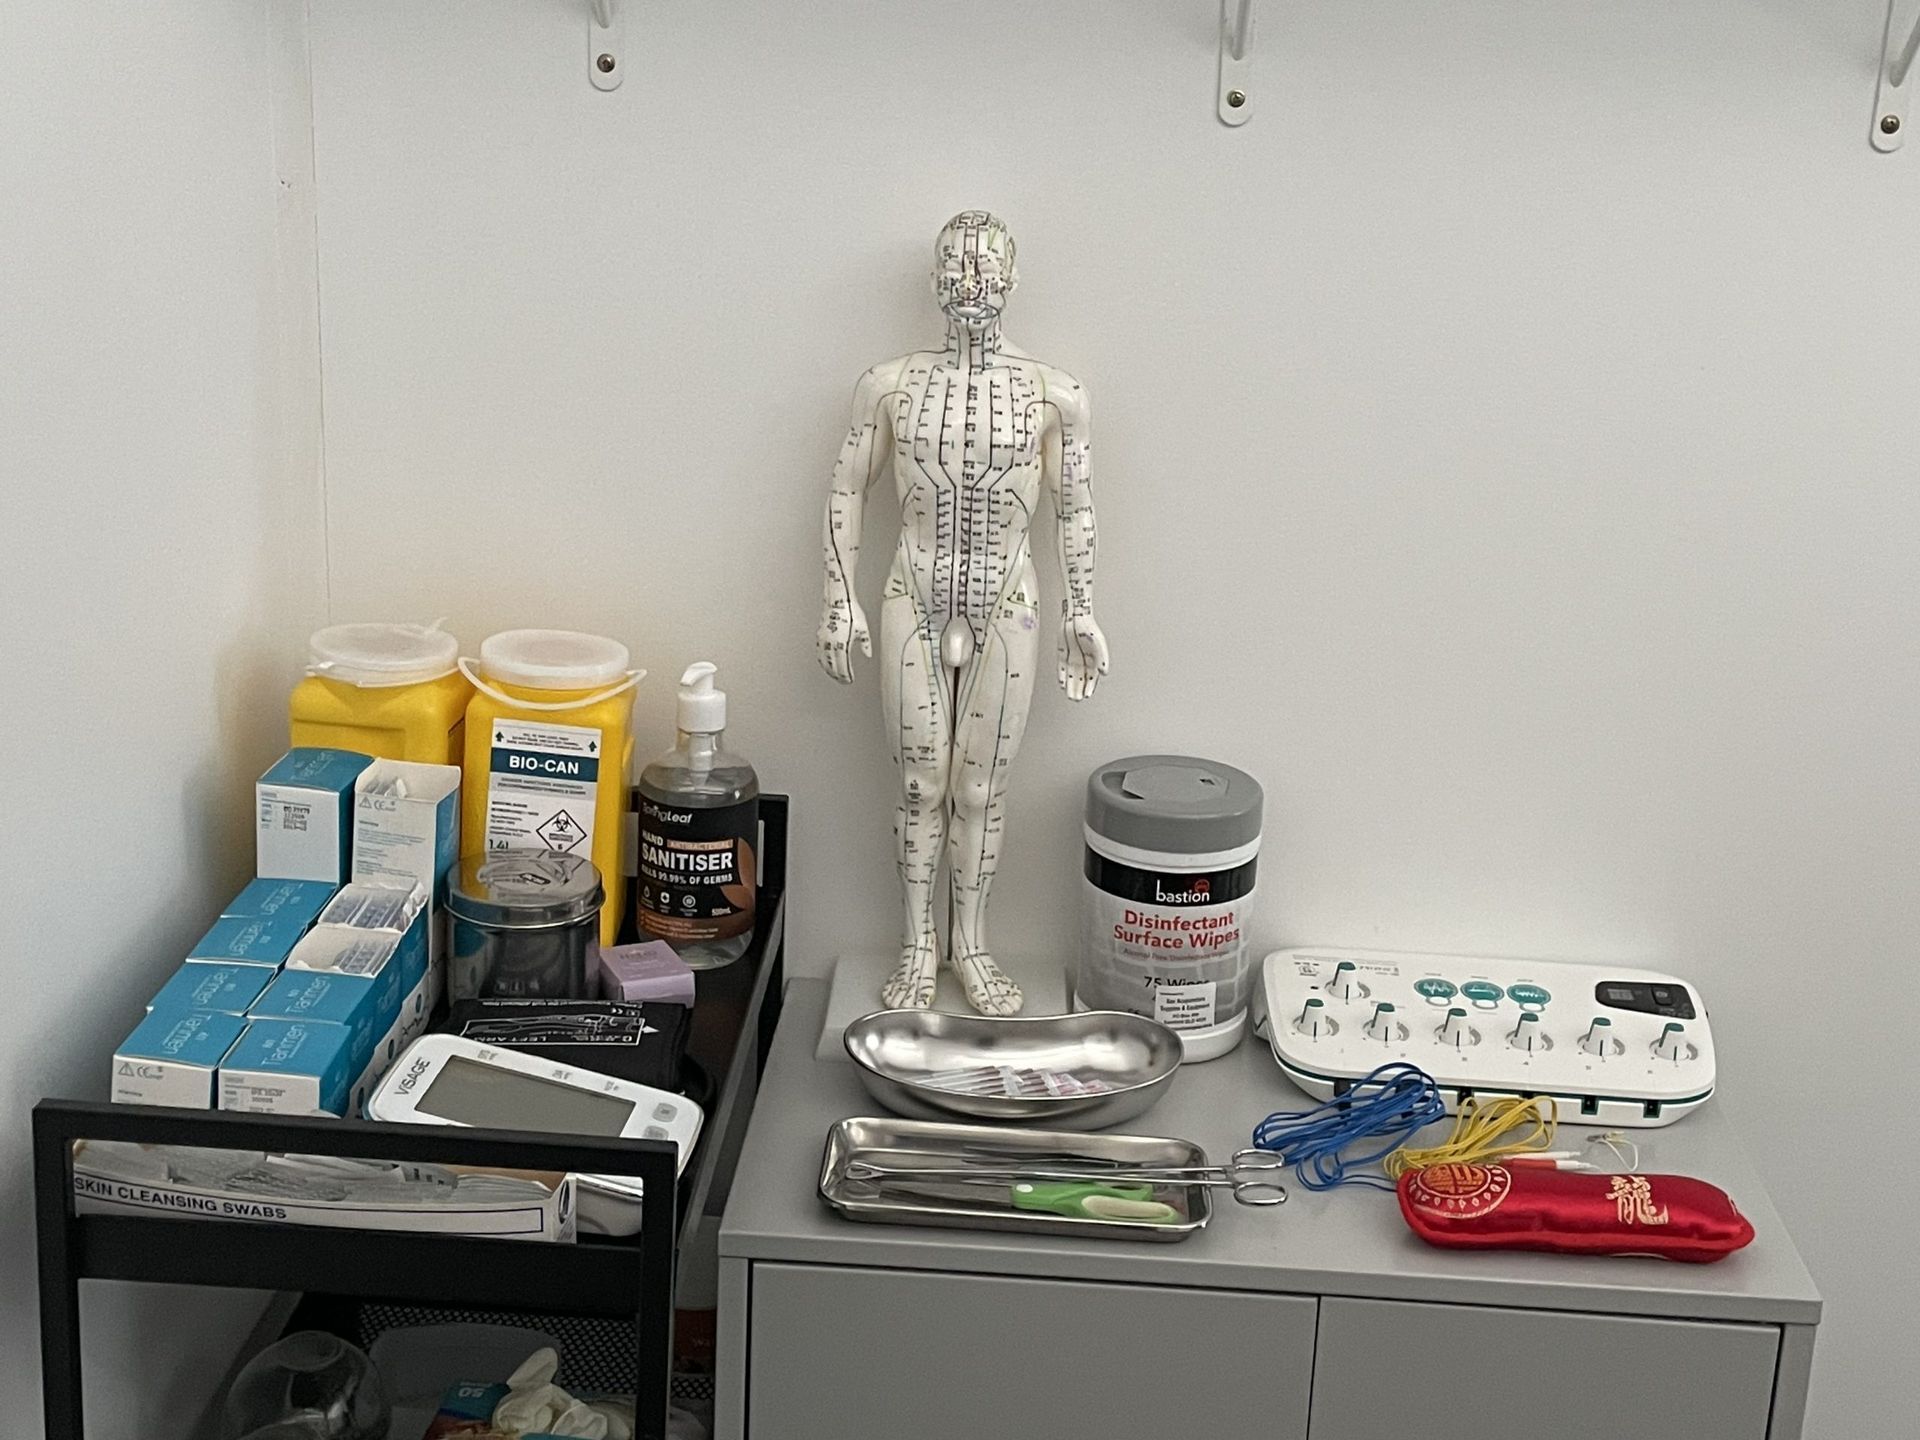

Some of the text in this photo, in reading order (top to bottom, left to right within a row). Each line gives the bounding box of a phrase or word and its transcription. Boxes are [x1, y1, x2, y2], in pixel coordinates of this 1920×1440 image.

[509, 755, 579, 775] BIO-CAN
[642, 843, 733, 871] SANITISER
[689, 876, 700, 885] OF
[703, 873, 733, 885] GERMS
[1156, 879, 1210, 903] bastion
[1124, 909, 1234, 931] Disinfectant
[1114, 924, 1240, 950] Surface Wipes
[1144, 976, 1162, 988] 75
[74, 1176, 287, 1219] SKIN CLEANSING SWABS
[458, 1387, 487, 1398] 50
